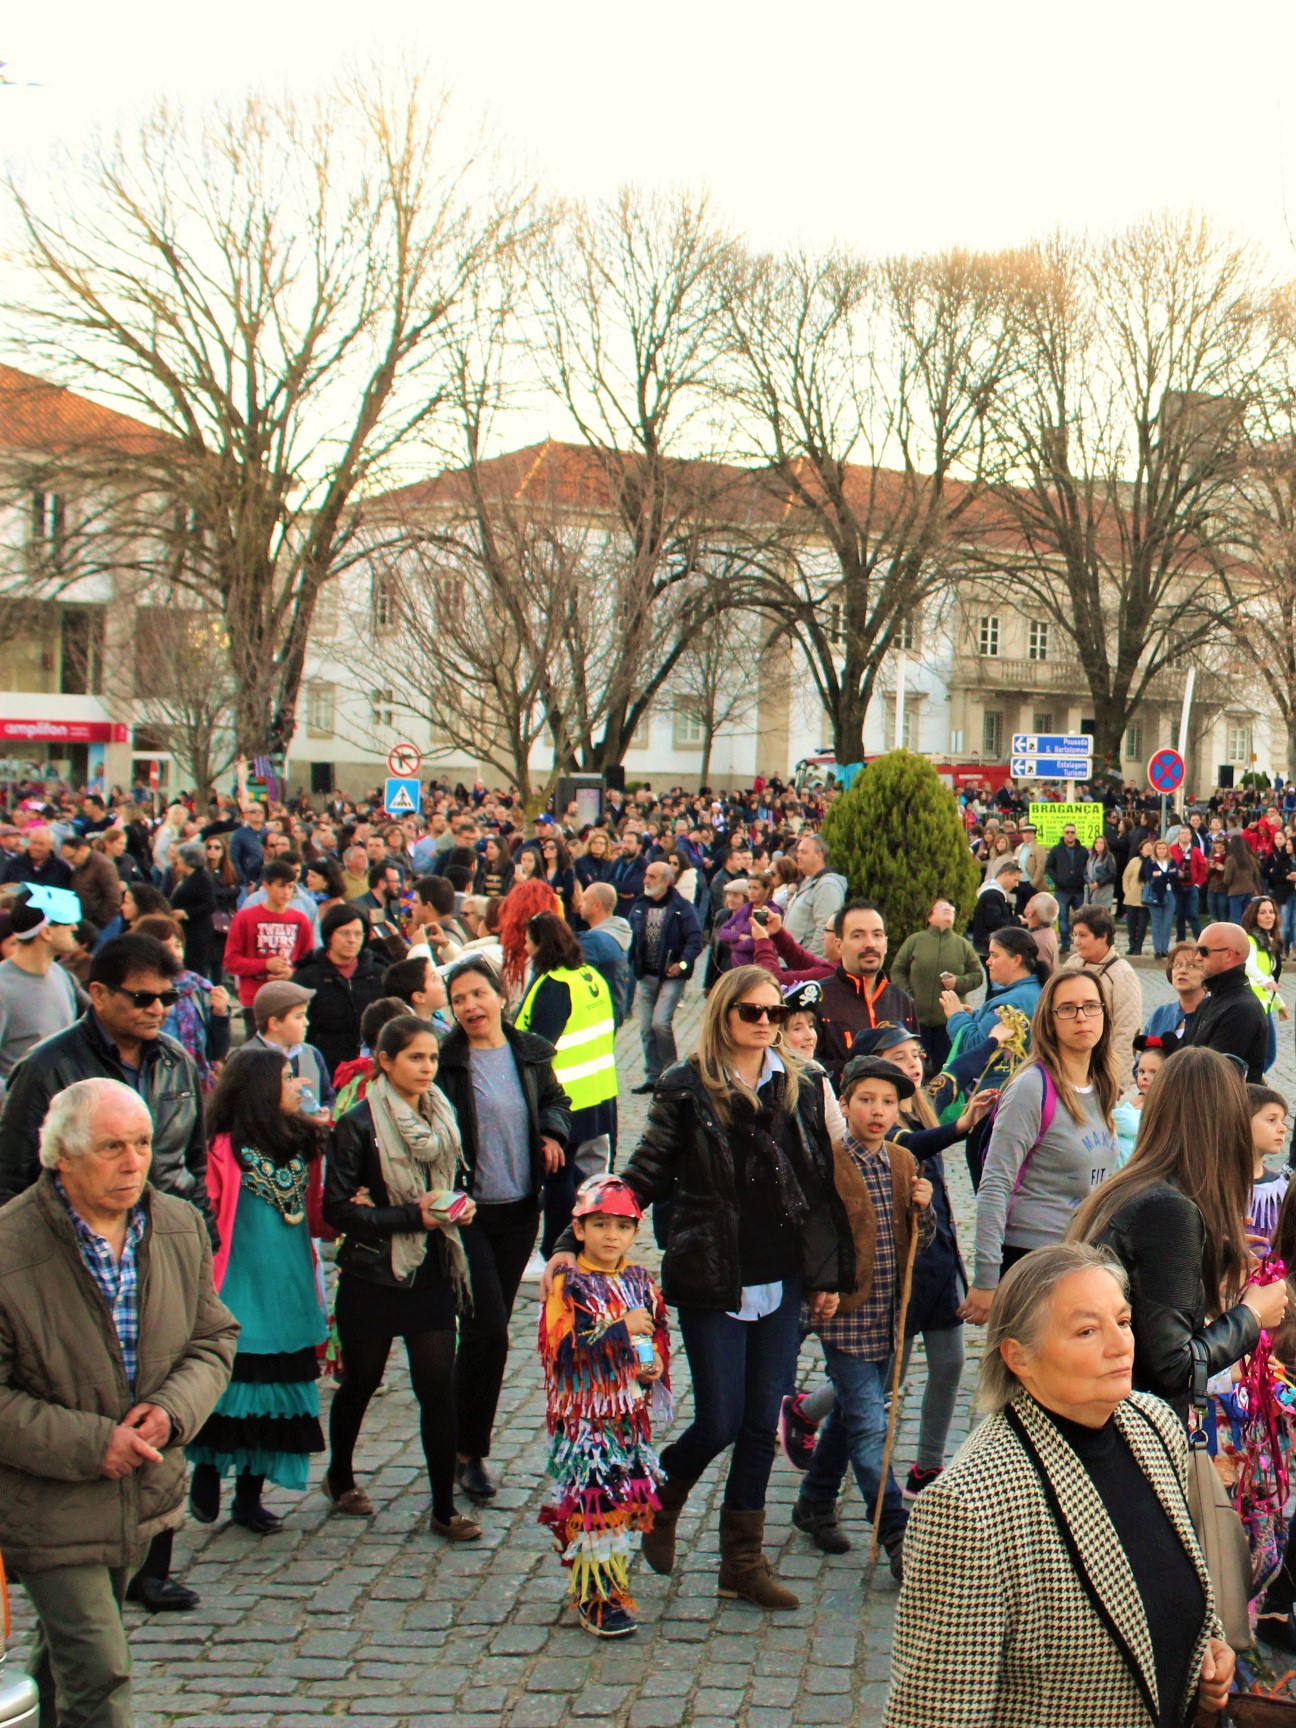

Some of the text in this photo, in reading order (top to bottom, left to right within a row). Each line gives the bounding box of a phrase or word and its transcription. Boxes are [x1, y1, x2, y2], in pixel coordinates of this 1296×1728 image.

[4, 721, 68, 739] amplifon
[1063, 738, 1088, 746] Pousada
[1045, 745, 1088, 754] S. Bartolomeu
[1056, 760, 1087, 769] Estalagem
[1063, 768, 1087, 777] Turismo
[1032, 804, 1100, 814] BRAGANÇA
[1087, 824, 1101, 840] 28
[1090, 1167, 1106, 1186] FIT
